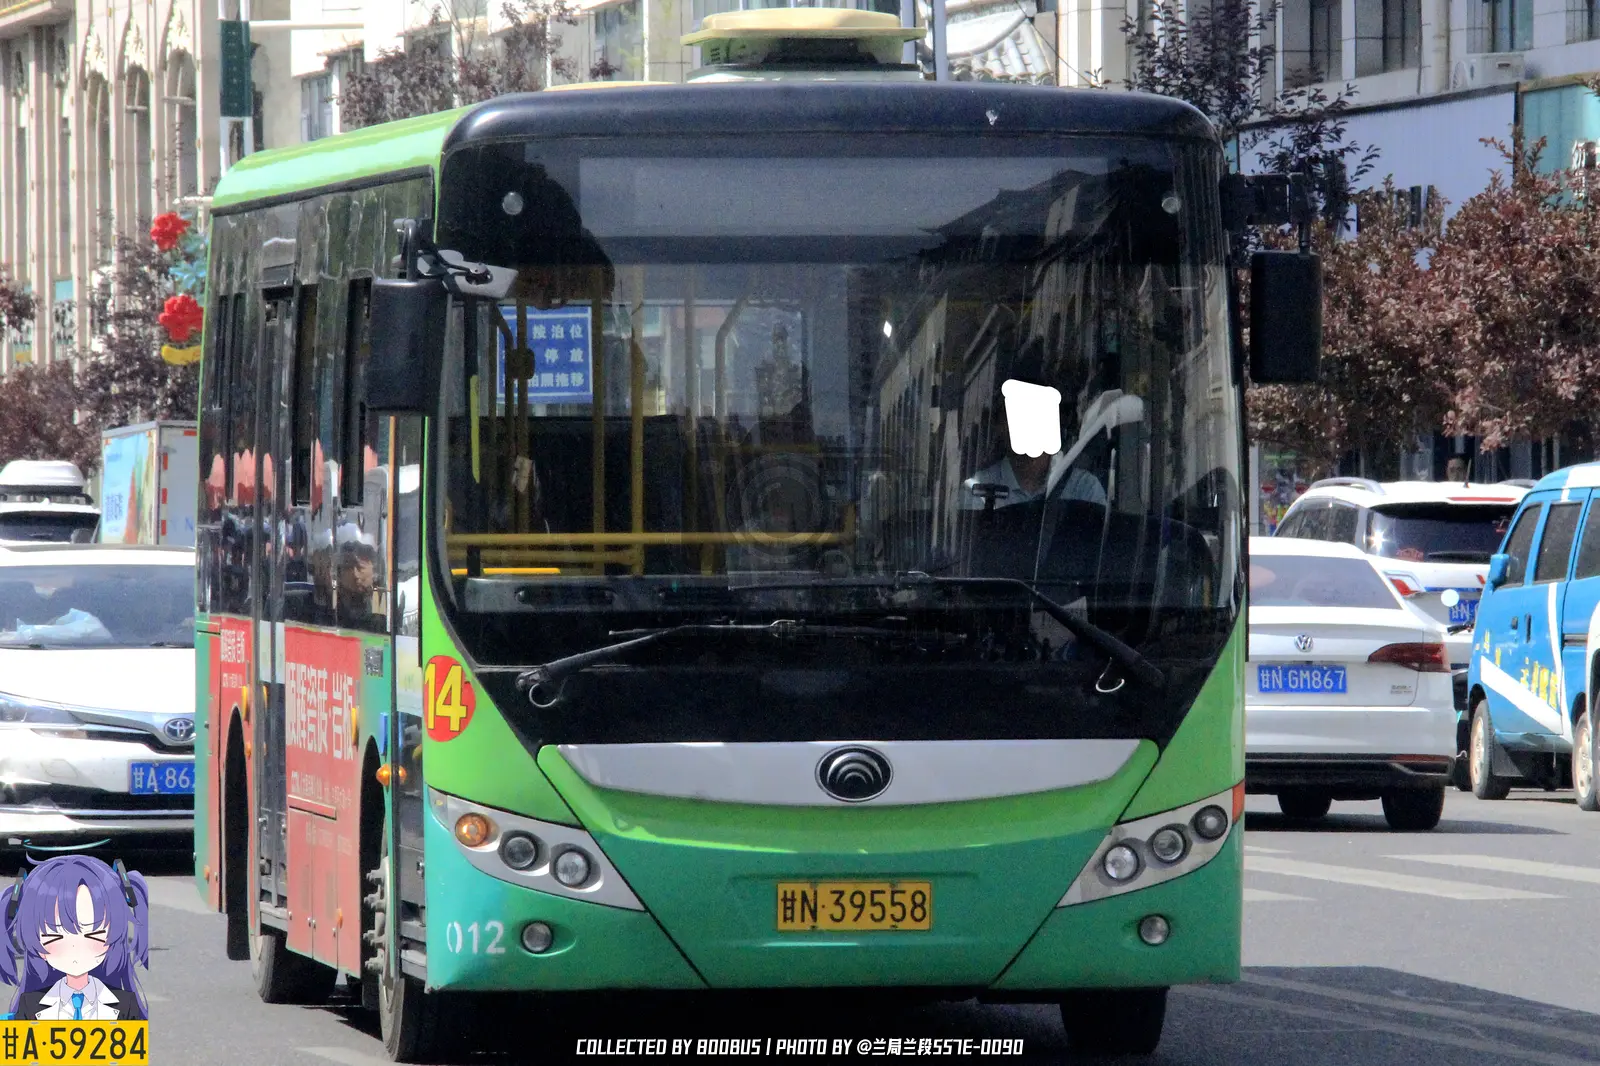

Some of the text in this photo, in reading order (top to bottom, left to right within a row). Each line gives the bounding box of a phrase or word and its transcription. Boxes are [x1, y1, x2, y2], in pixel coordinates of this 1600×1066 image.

[424, 663, 467, 732] 14
[133, 767, 195, 789] 甘A·86
[781, 889, 927, 923] 甘N·39558
[446, 920, 505, 954] 012
